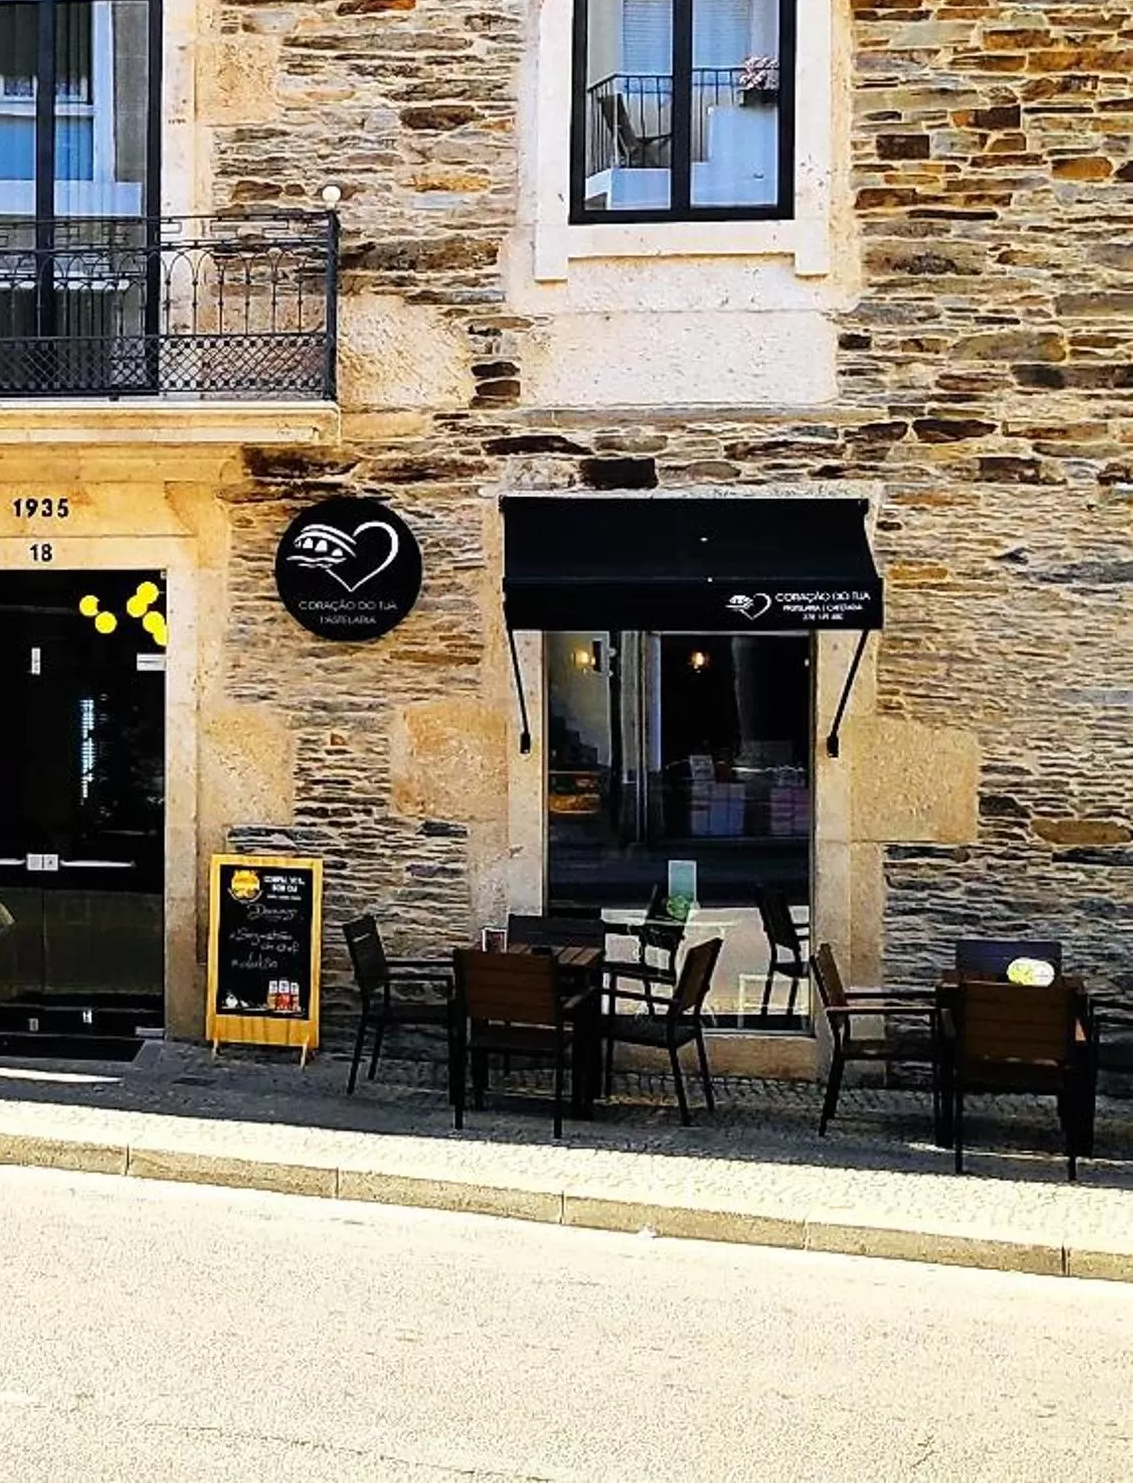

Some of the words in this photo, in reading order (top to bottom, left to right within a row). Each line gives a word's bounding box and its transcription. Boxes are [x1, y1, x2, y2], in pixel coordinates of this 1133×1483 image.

[13, 498, 69, 518] 1935
[29, 543, 53, 562] 18
[775, 591, 831, 602] CORAÇÃO
[832, 591, 849, 600] DO
[852, 591, 871, 600] TUA
[298, 599, 356, 612] CORAÇÃO
[357, 600, 377, 611] DO
[378, 600, 398, 611] TUA
[320, 616, 377, 624] PASTELARIA
